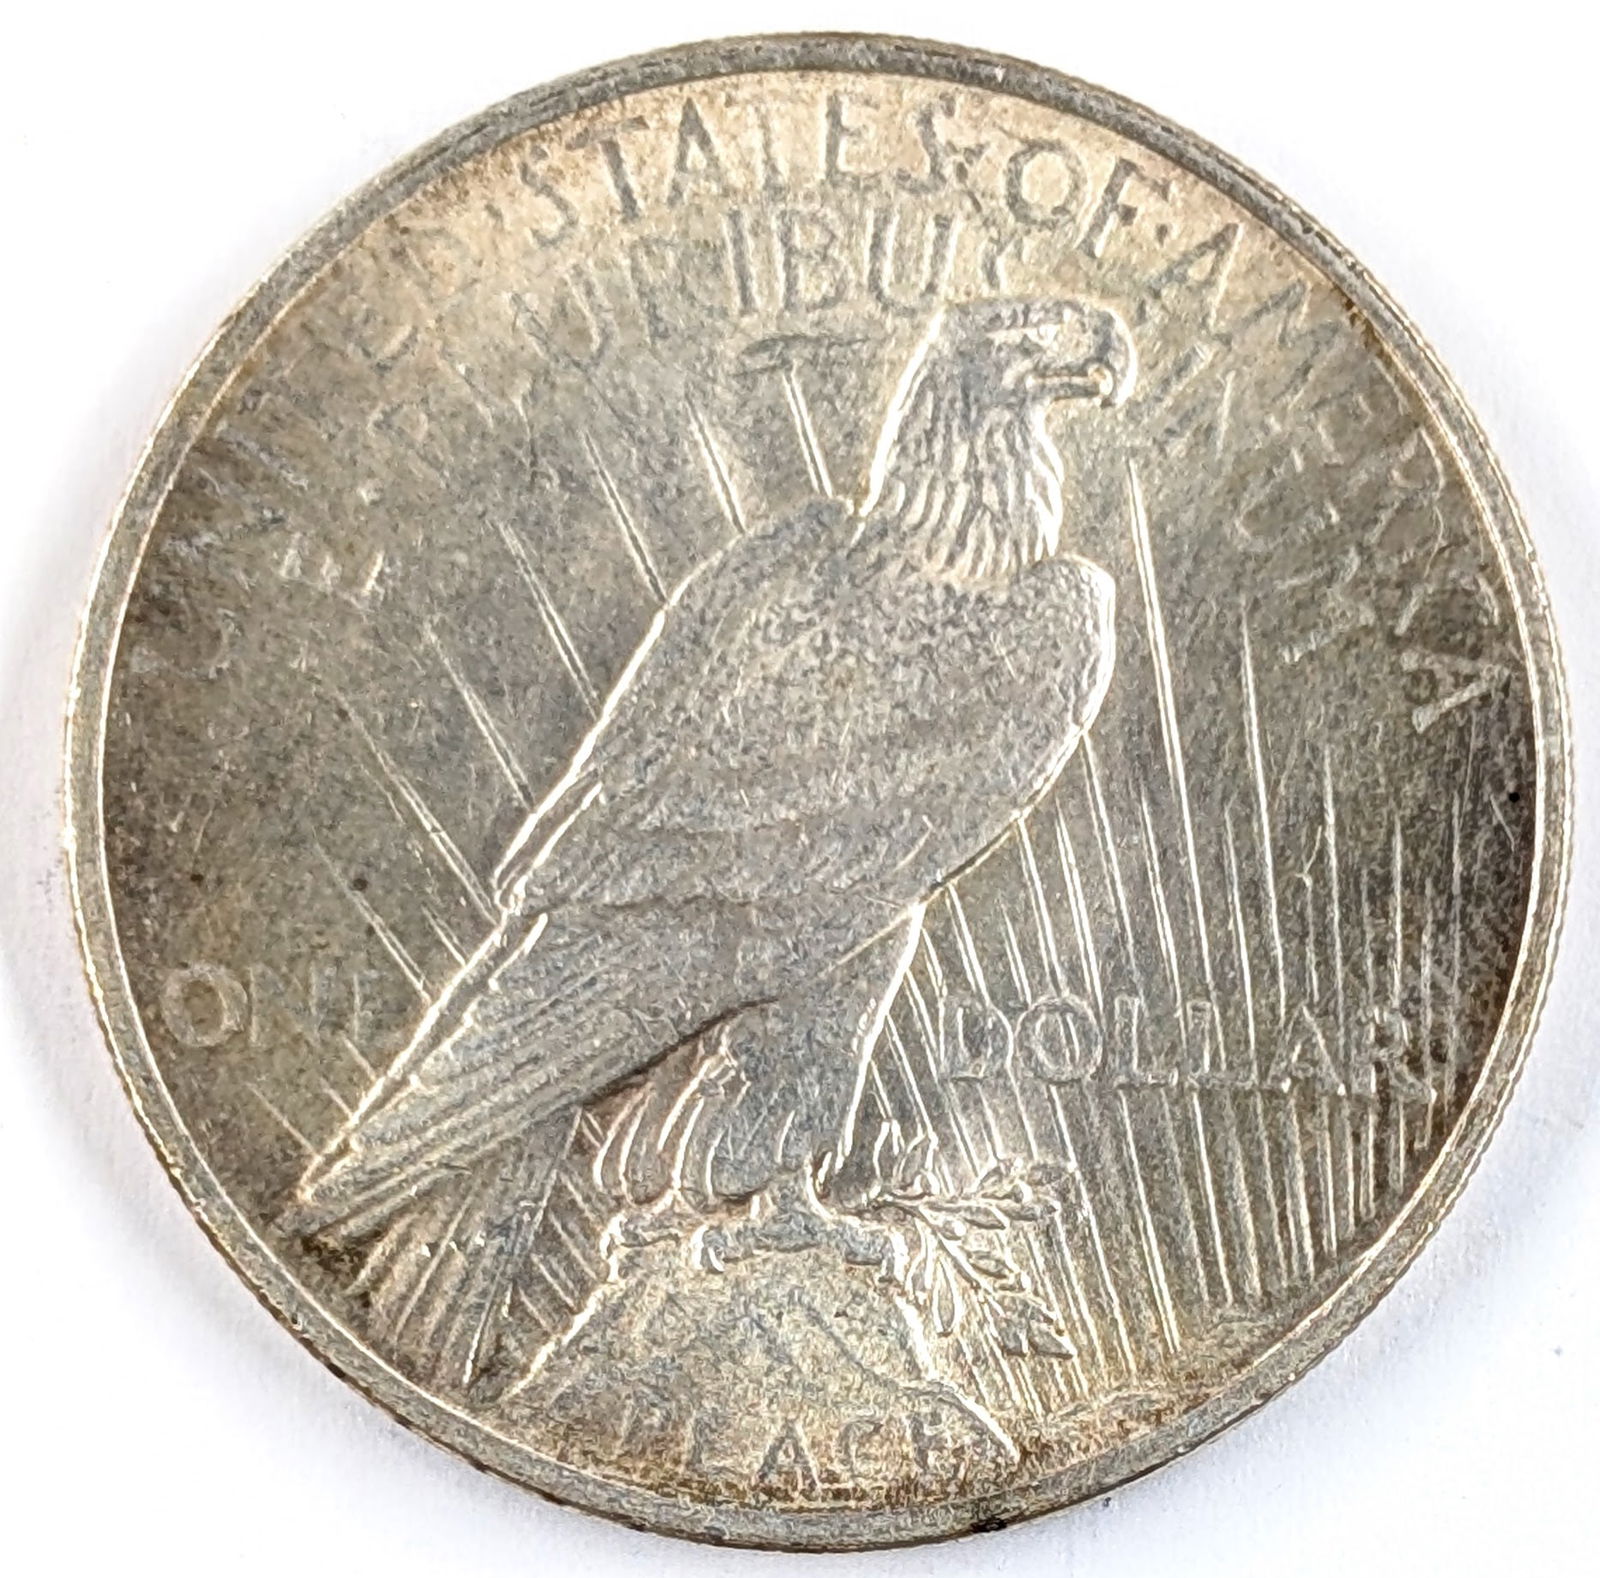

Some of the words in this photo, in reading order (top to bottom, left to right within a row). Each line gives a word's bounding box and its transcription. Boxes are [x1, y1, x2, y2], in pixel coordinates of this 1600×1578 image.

[515, 88, 966, 248] STATES
[1003, 138, 1176, 260] OF
[160, 962, 398, 1050] ONE
[938, 994, 1438, 1102] DOLLAR
